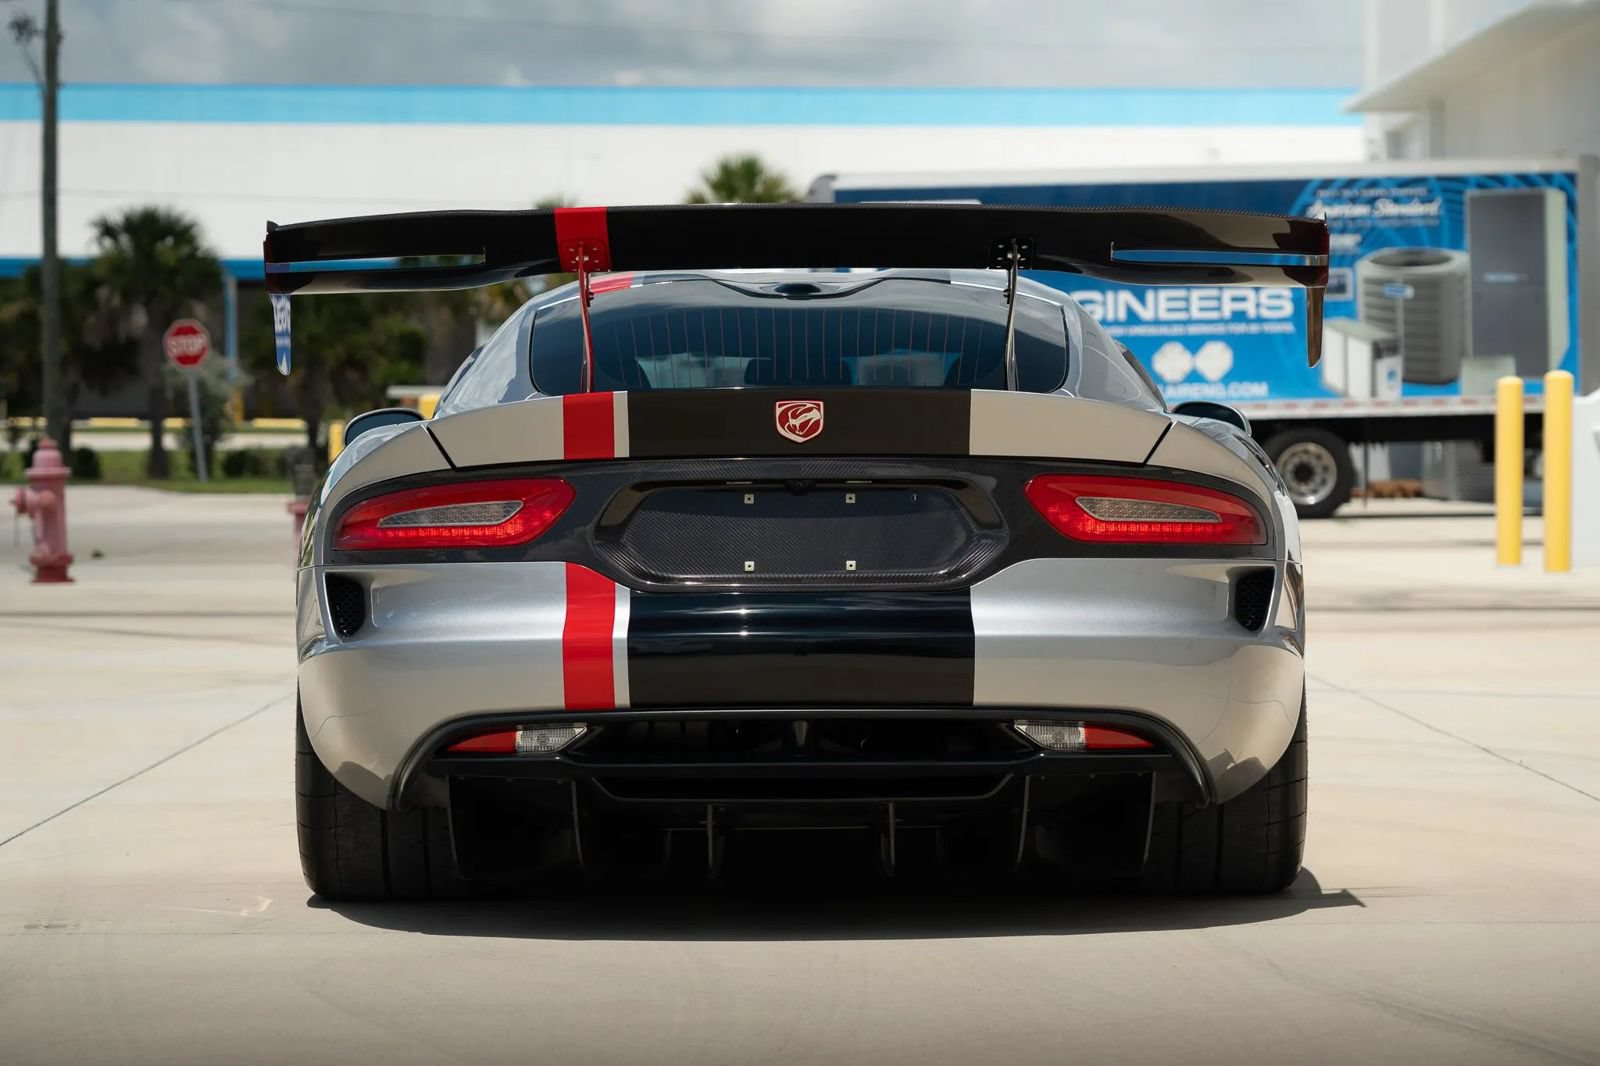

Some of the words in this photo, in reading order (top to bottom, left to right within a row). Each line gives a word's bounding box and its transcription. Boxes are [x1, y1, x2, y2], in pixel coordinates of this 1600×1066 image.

[1372, 197, 1442, 217] Standard
[1069, 287, 1295, 322] GINEERS
[166, 335, 207, 357] STOP
